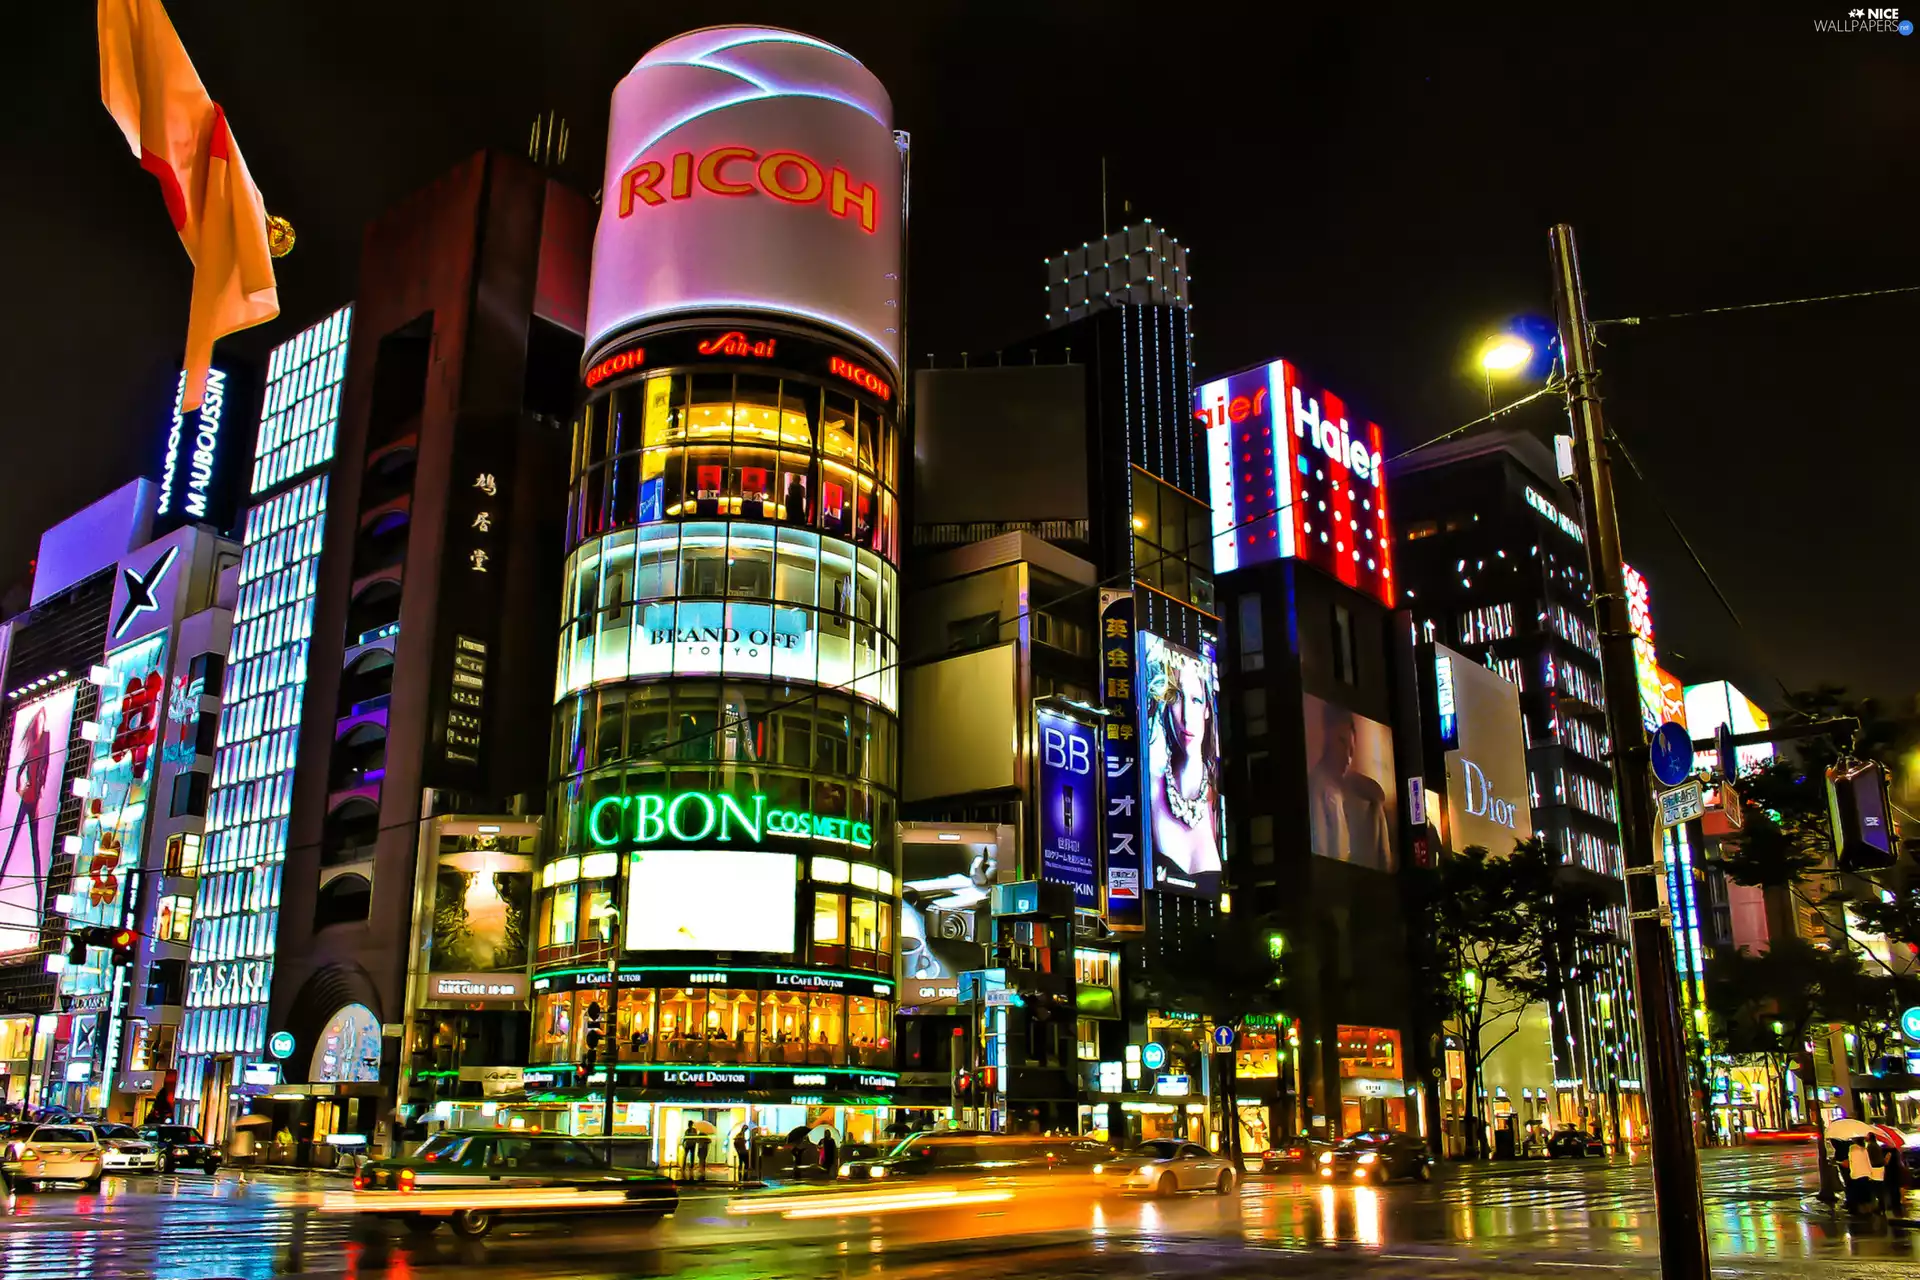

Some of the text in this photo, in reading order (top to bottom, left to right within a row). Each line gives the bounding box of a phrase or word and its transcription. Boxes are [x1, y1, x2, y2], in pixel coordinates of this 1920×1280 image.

[617, 146, 877, 234] RICOH
[585, 349, 644, 388] RICOH
[828, 356, 891, 399] RICOH
[1194, 386, 1268, 429] aier
[185, 367, 226, 517] MAUBOUSSIN
[1292, 386, 1382, 488] Haier
[651, 628, 799, 649] BRAND OFF
[1045, 727, 1090, 775] B.B
[1107, 755, 1136, 856] ジオス
[1460, 758, 1516, 829] Dior
[589, 791, 872, 845] C'BON COSMETCS
[190, 961, 266, 993] TASAKI
[706, 1072, 746, 1083] DOUTOR
